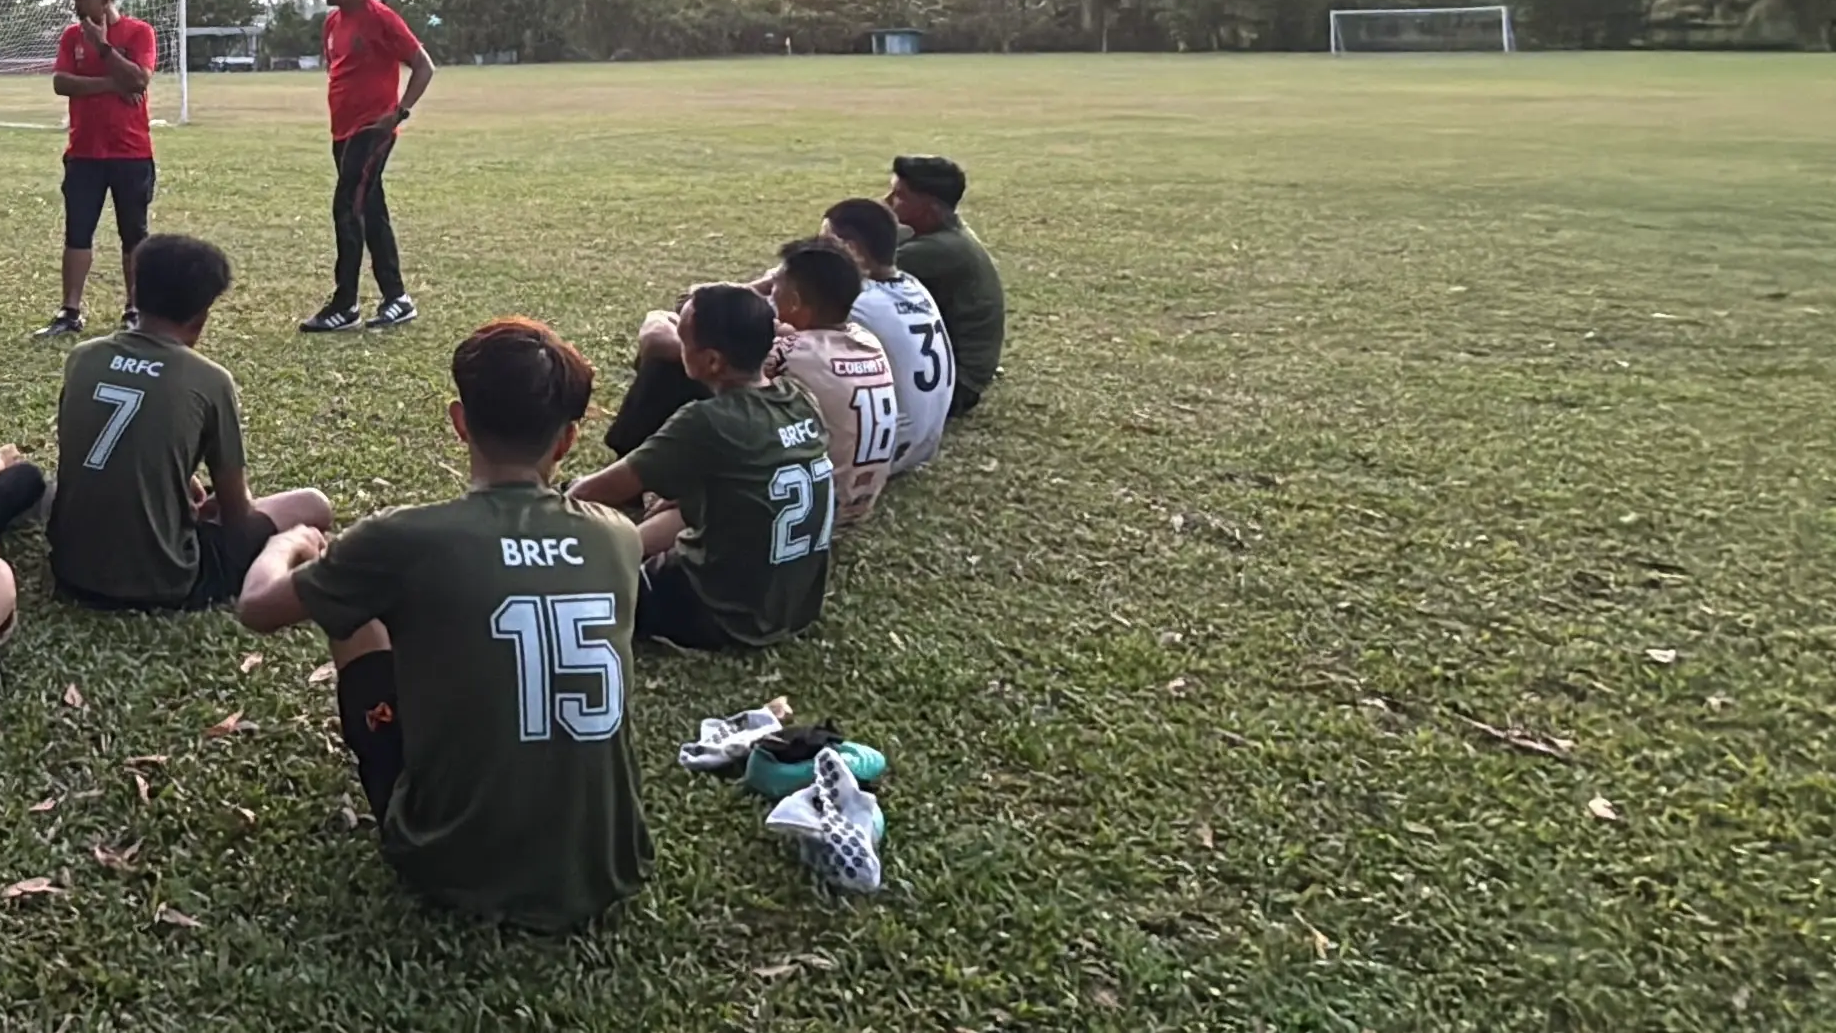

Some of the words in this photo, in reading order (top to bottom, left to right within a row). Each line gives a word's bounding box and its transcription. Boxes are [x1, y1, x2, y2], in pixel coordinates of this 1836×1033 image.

[110, 355, 164, 377] BRFC
[909, 319, 952, 392] 31
[83, 381, 145, 470] 7
[778, 418, 819, 448] BRFC
[850, 382, 898, 466] 18
[500, 537, 584, 566] BRFC
[490, 593, 624, 742] 15
